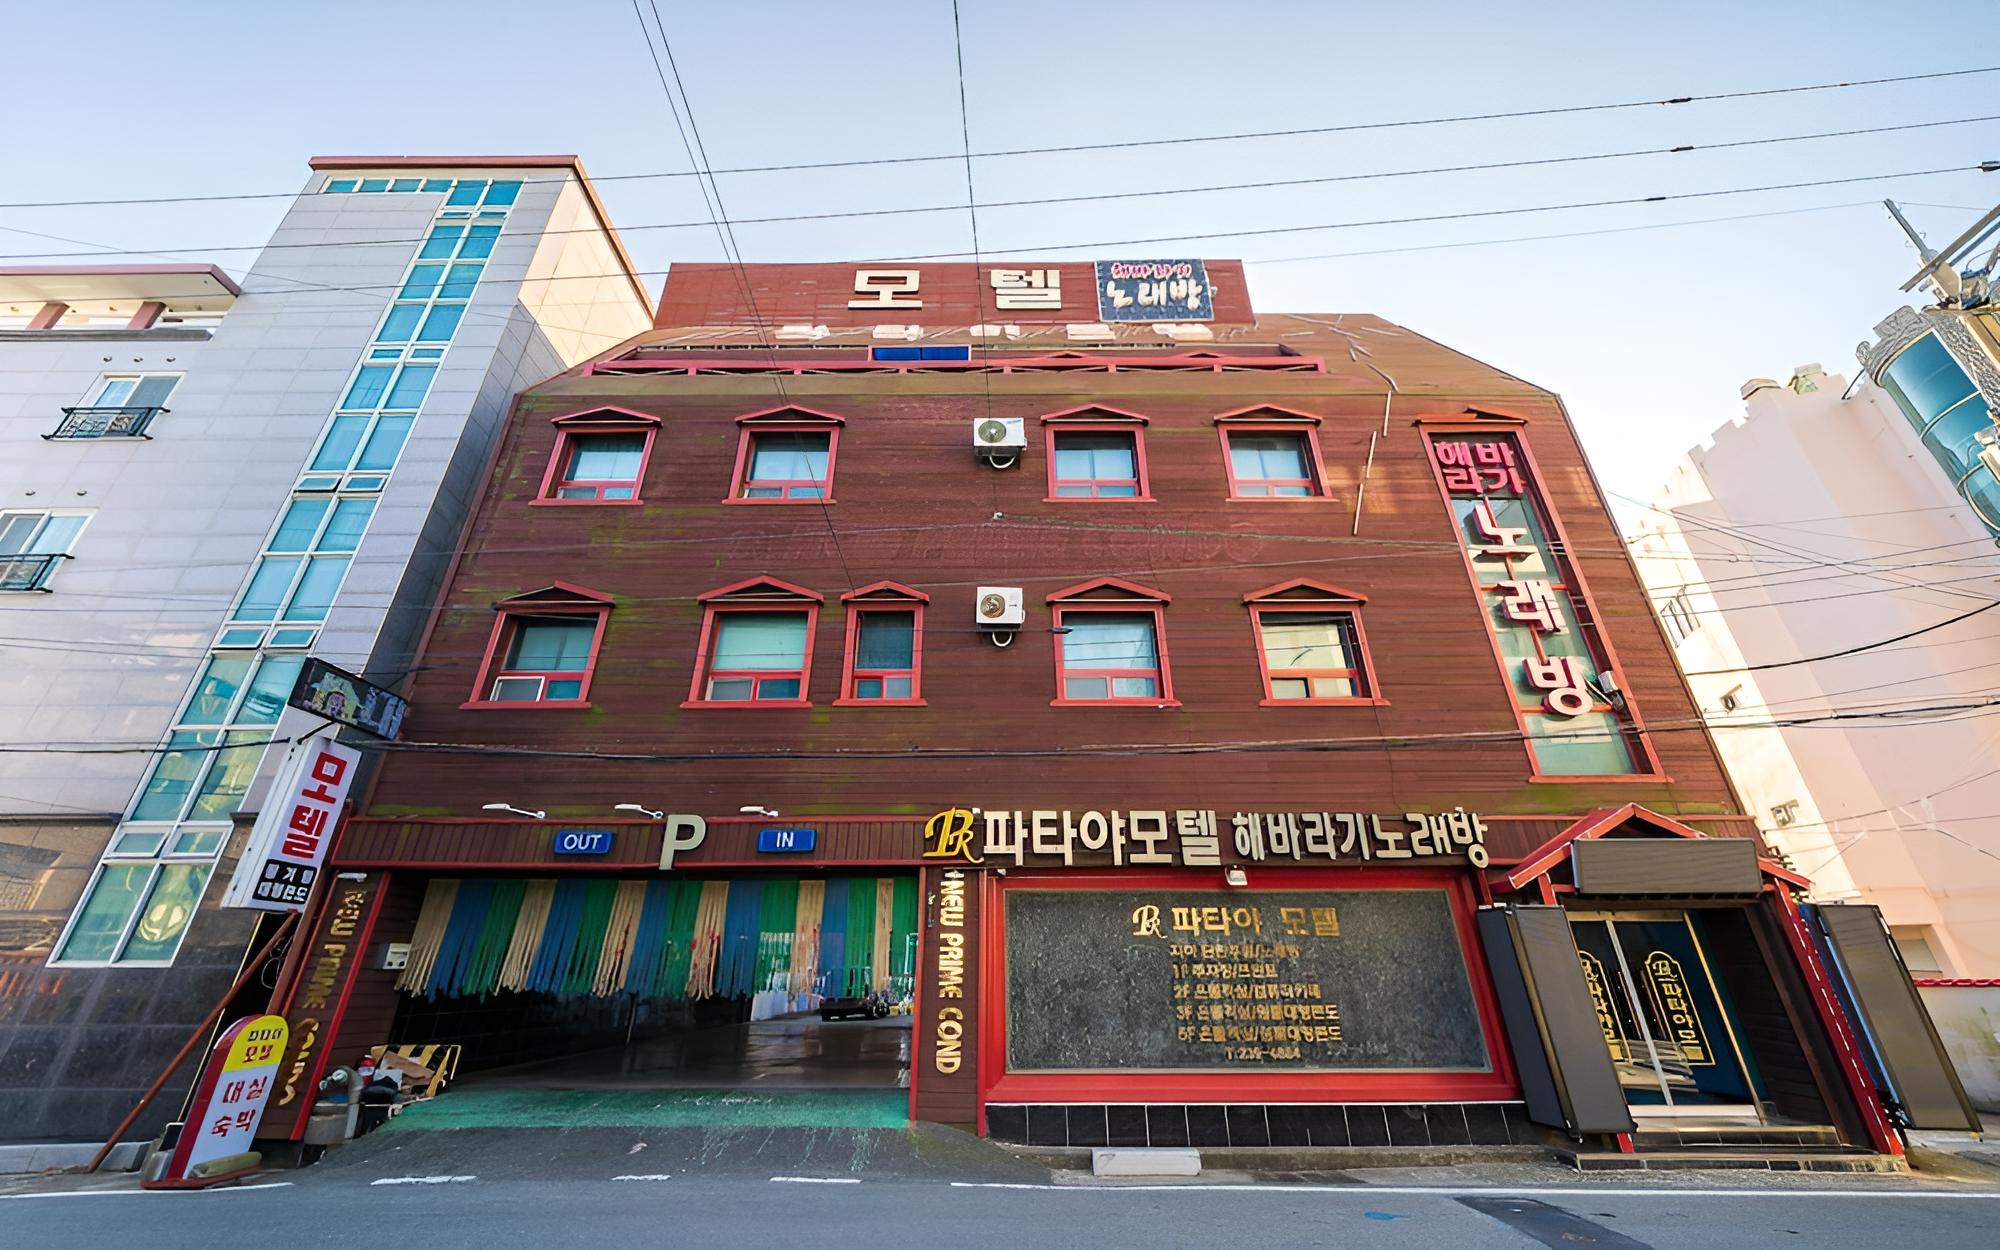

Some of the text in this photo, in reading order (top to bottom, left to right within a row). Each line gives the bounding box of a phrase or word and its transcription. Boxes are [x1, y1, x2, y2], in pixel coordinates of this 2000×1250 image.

[1106, 278, 1203, 311] 노래방
[1467, 503, 1593, 717] 노래방
[282, 751, 348, 860] 모텔
[563, 833, 602, 851] OUT
[658, 814, 707, 871] P
[776, 830, 794, 848] IN
[983, 808, 1221, 866] 파타야모텔
[1232, 806, 1489, 868] 해바라기노래방
[938, 933, 965, 998] PRIME
[935, 1007, 963, 1074] COND
[210, 1109, 257, 1138] 숙박
